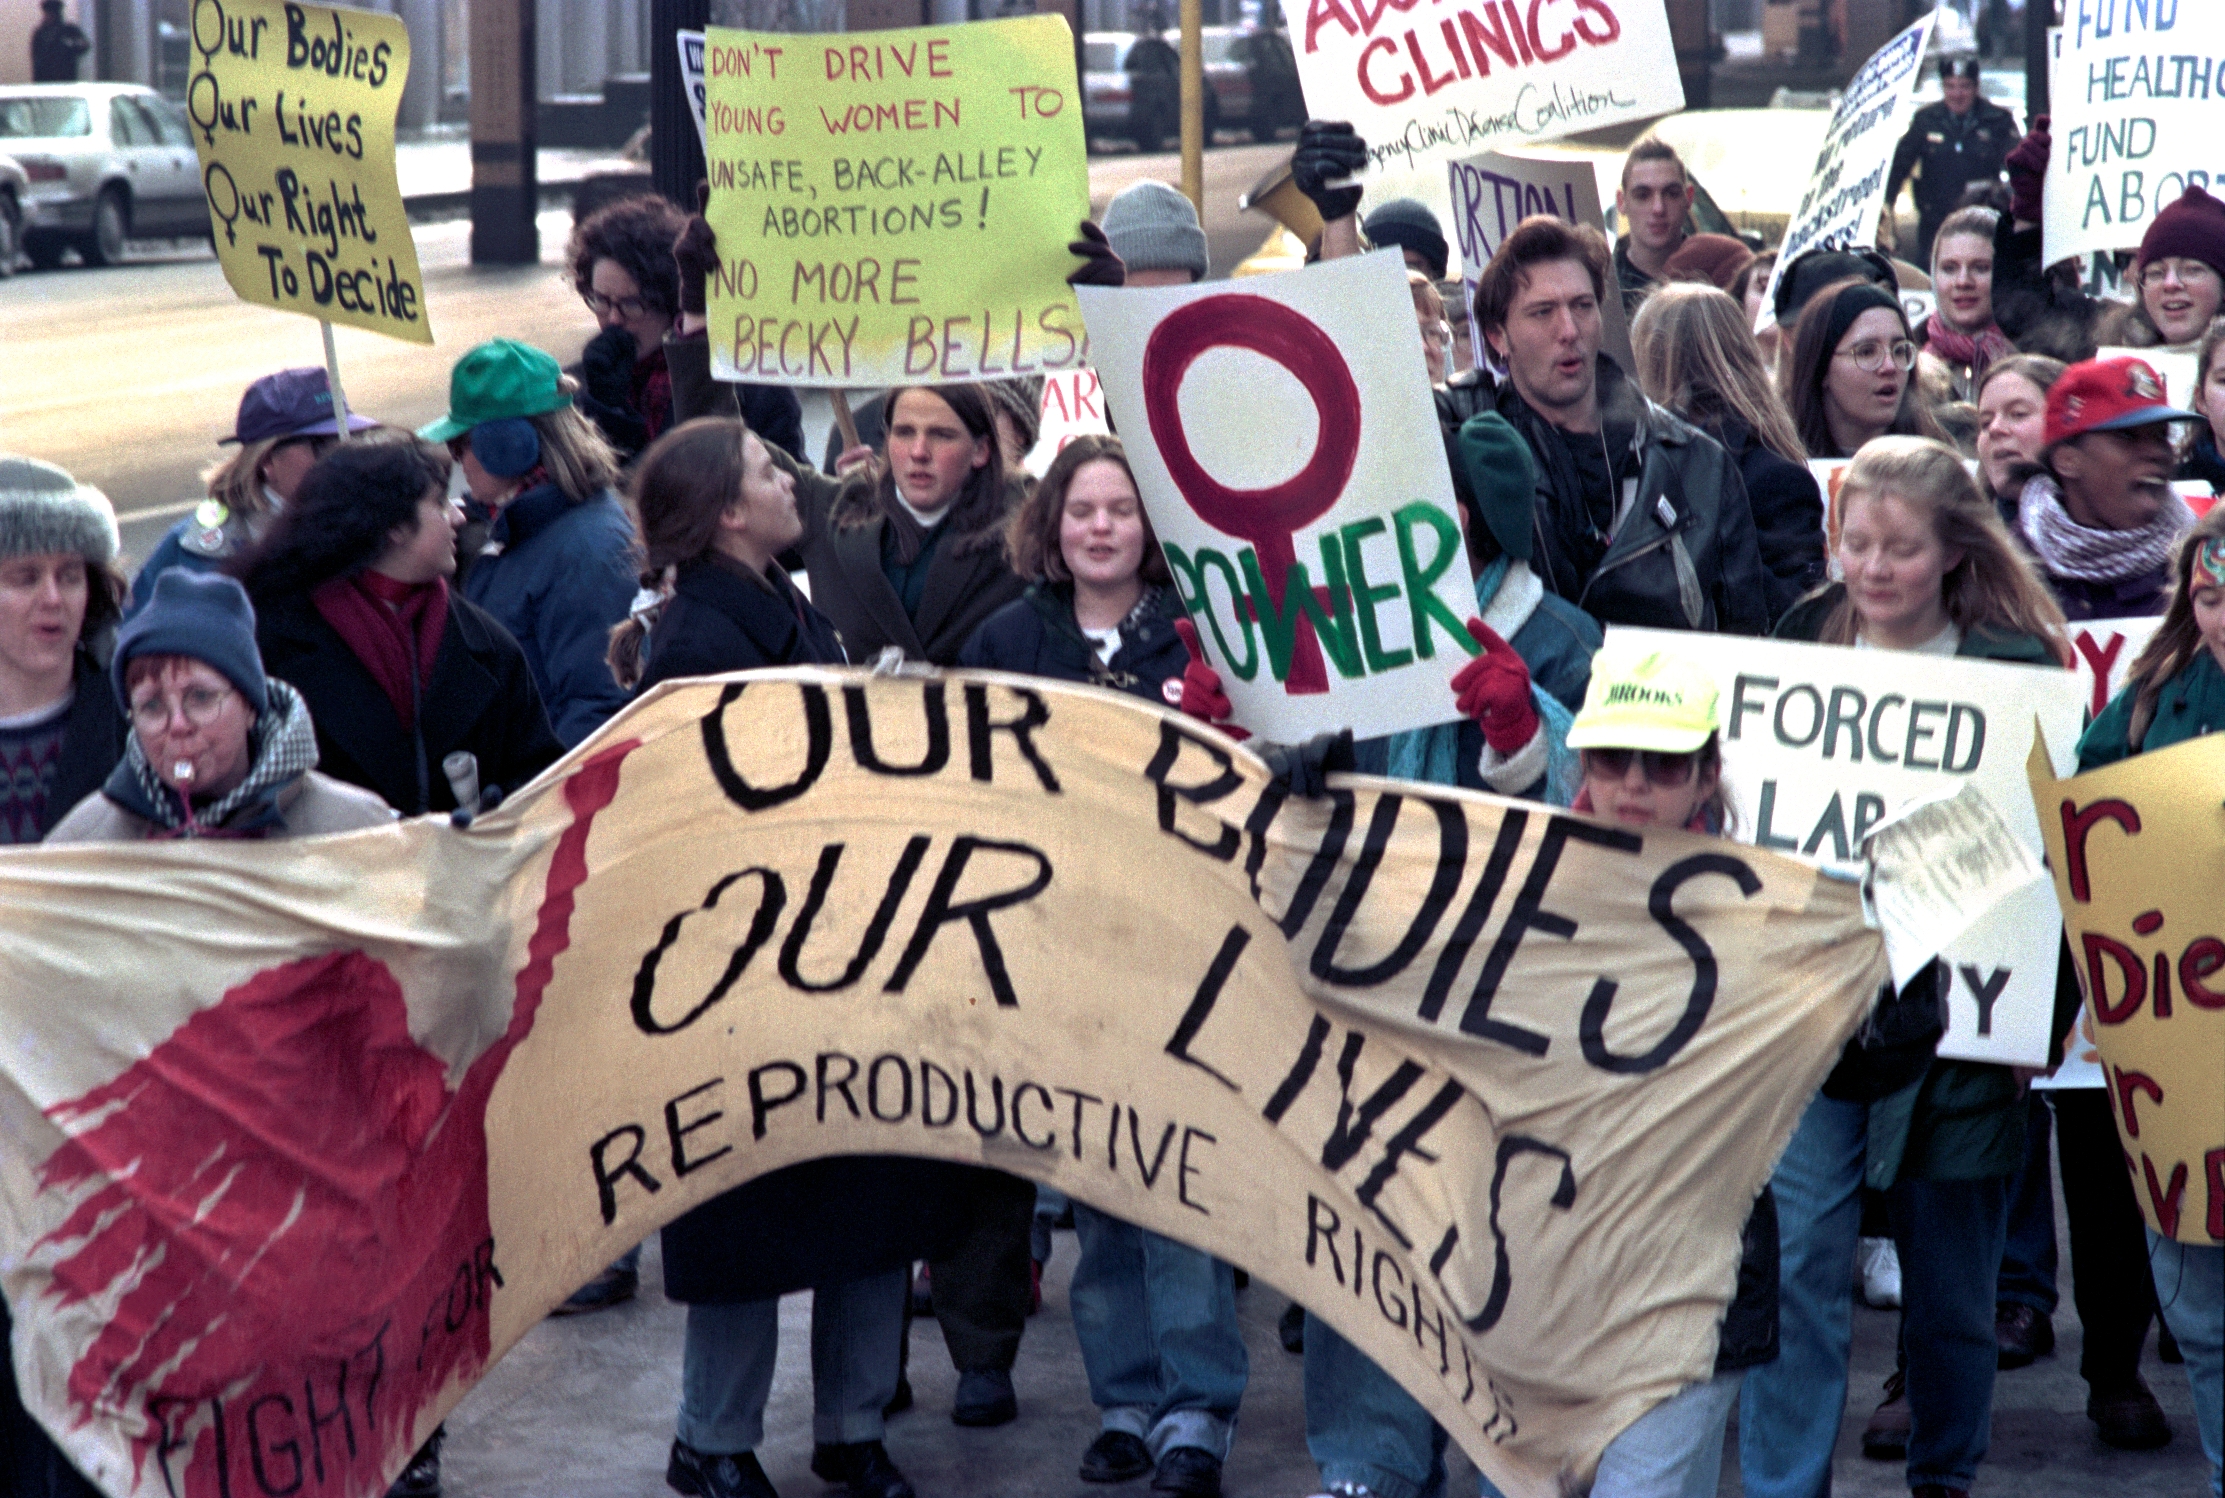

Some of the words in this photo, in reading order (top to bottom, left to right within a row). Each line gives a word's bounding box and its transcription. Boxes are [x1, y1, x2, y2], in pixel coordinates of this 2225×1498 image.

[193, 0, 267, 60] Our
[284, 4, 391, 88] Bodies
[712, 42, 783, 80] DON'T
[825, 40, 953, 81] DRIVE
[1357, 0, 1621, 107] CLINICS
[188, 70, 257, 140] Our
[275, 90, 363, 160] Lives
[710, 98, 786, 136] YOUNG
[819, 98, 960, 134] WOMEN
[1008, 85, 1064, 119] TO
[2067, 117, 2157, 174] FUND
[205, 162, 273, 238] Our
[276, 168, 376, 259] Right
[712, 158, 818, 199] UNSAFE,
[834, 146, 1043, 190] BACK-ALLEY
[257, 246, 298, 300] To
[306, 252, 417, 321] Decide
[712, 259, 758, 300] NO
[791, 258, 922, 304] MORE
[734, 314, 860, 377] BECKY
[1162, 500, 1487, 685] POWER
[1728, 672, 1986, 773] FORCED
[701, 681, 1063, 811] OUR
[1145, 717, 1763, 1076] BODIES
[631, 834, 1054, 1034] OUR
[1164, 924, 1577, 1333] LIVES
[590, 1052, 1218, 1226] REPRODUCTIVE
[146, 1318, 392, 1498] FIGHT
